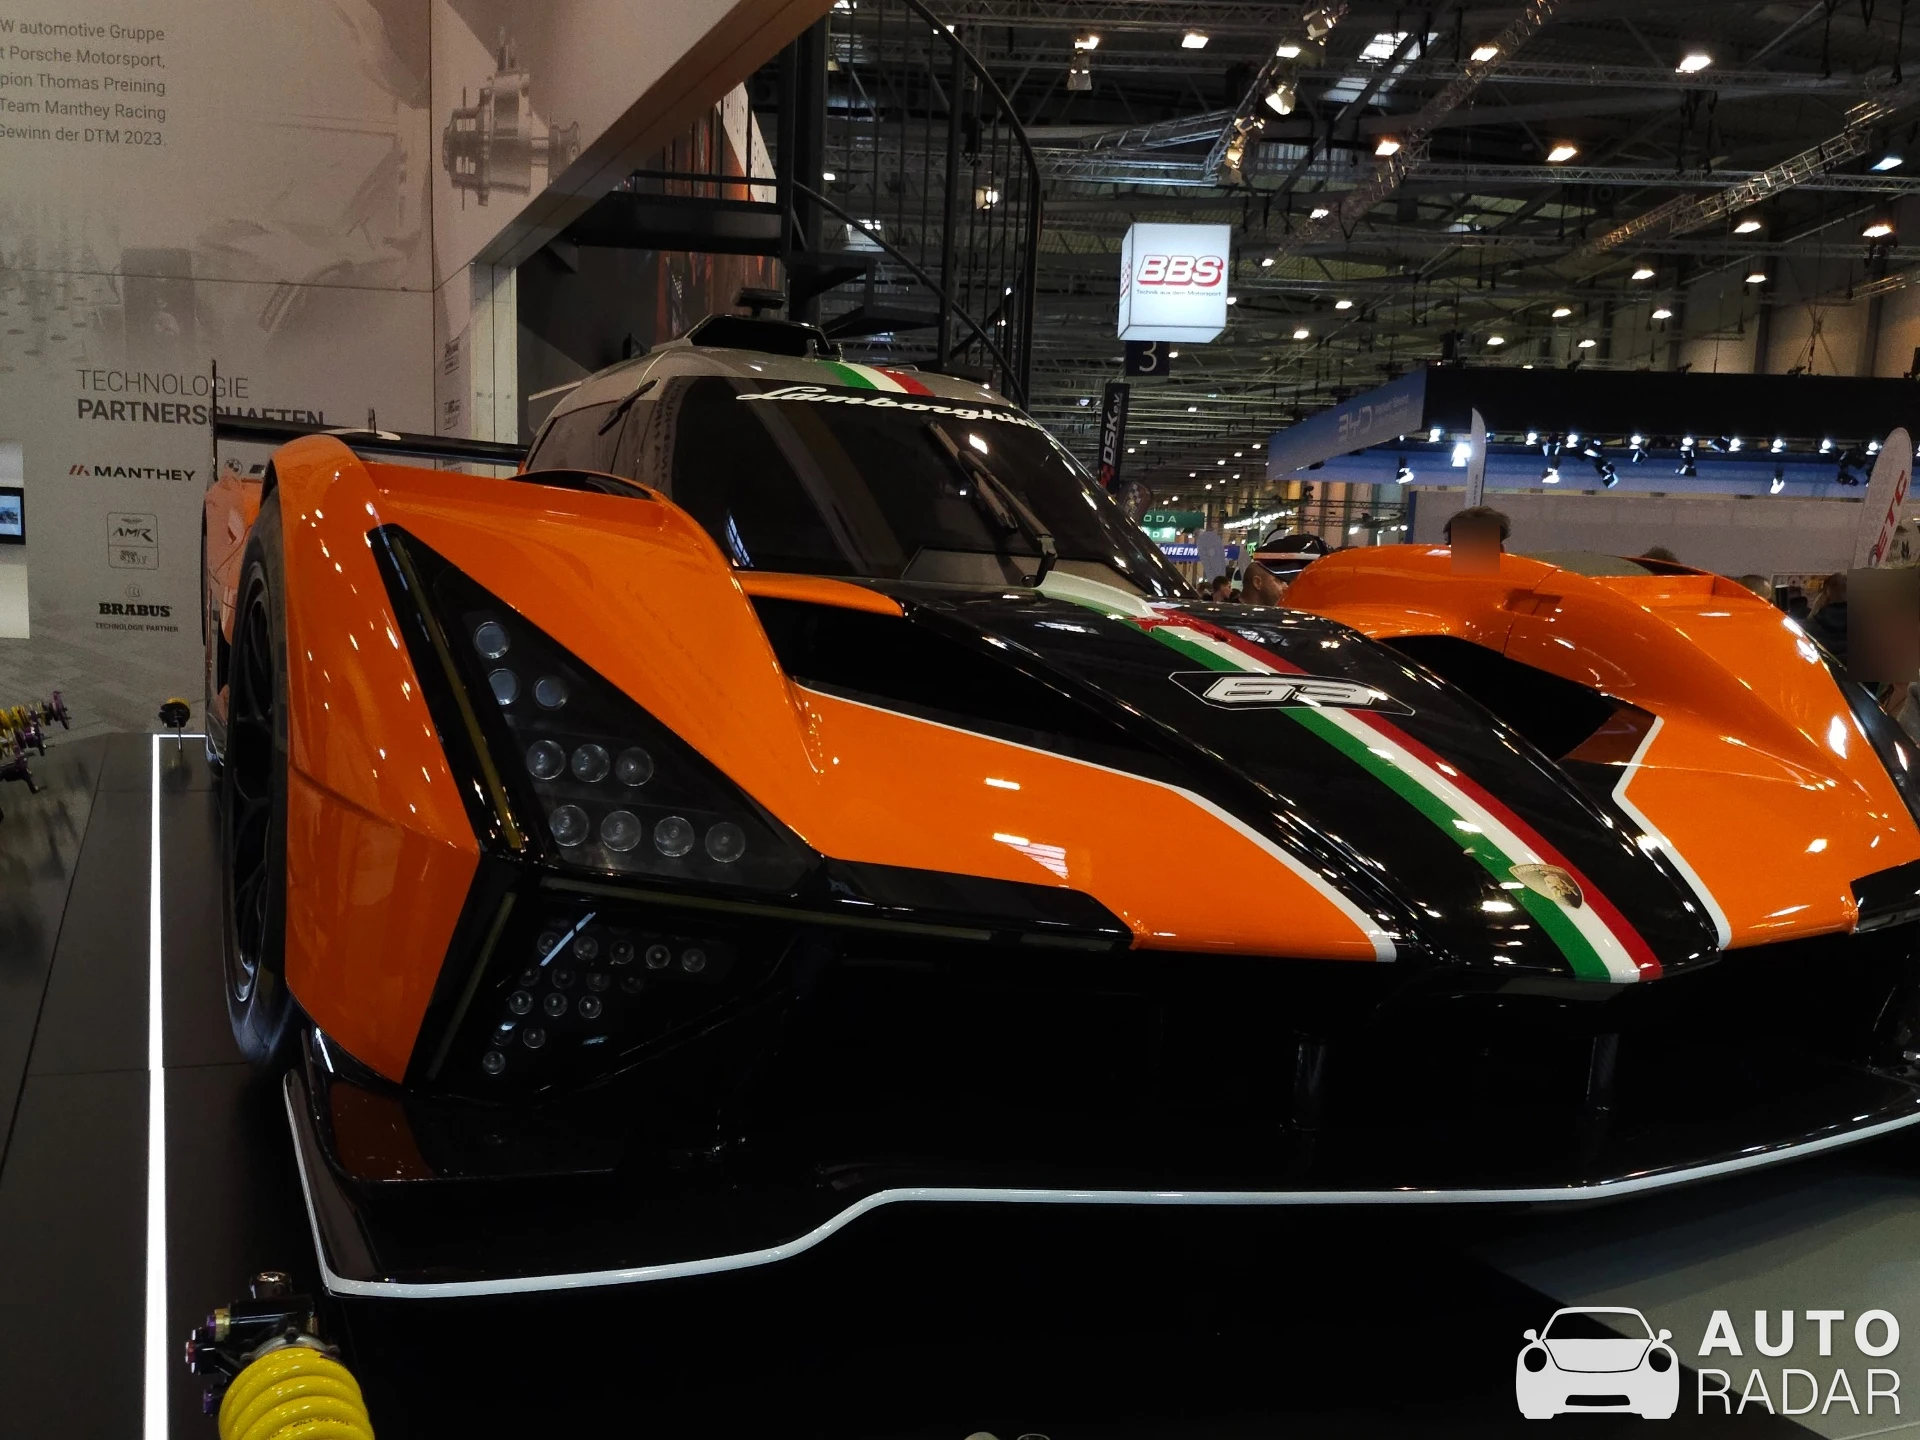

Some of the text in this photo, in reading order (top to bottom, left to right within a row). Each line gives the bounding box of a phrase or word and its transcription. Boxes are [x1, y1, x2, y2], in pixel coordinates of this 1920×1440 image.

[20, 22, 105, 38] automotive
[110, 24, 165, 44] Gruppe
[10, 46, 72, 62] Porsche
[76, 49, 166, 68] Motorsport,
[37, 73, 99, 90] Thomas
[104, 77, 166, 97] Preining
[45, 100, 110, 121] Manthey
[115, 103, 166, 123] Racing
[55, 127, 80, 142] der
[84, 128, 120, 144] DTM
[124, 130, 167, 146] 2023.
[1137, 254, 1224, 288] BBS
[1139, 342, 1157, 372] 3
[1102, 411, 1119, 466] DSK
[94, 465, 196, 482] MANTHEY
[112, 527, 154, 543] AMR
[99, 602, 171, 618] BRABUS
[95, 622, 179, 633] TECHNOLOGIE PARTNER
